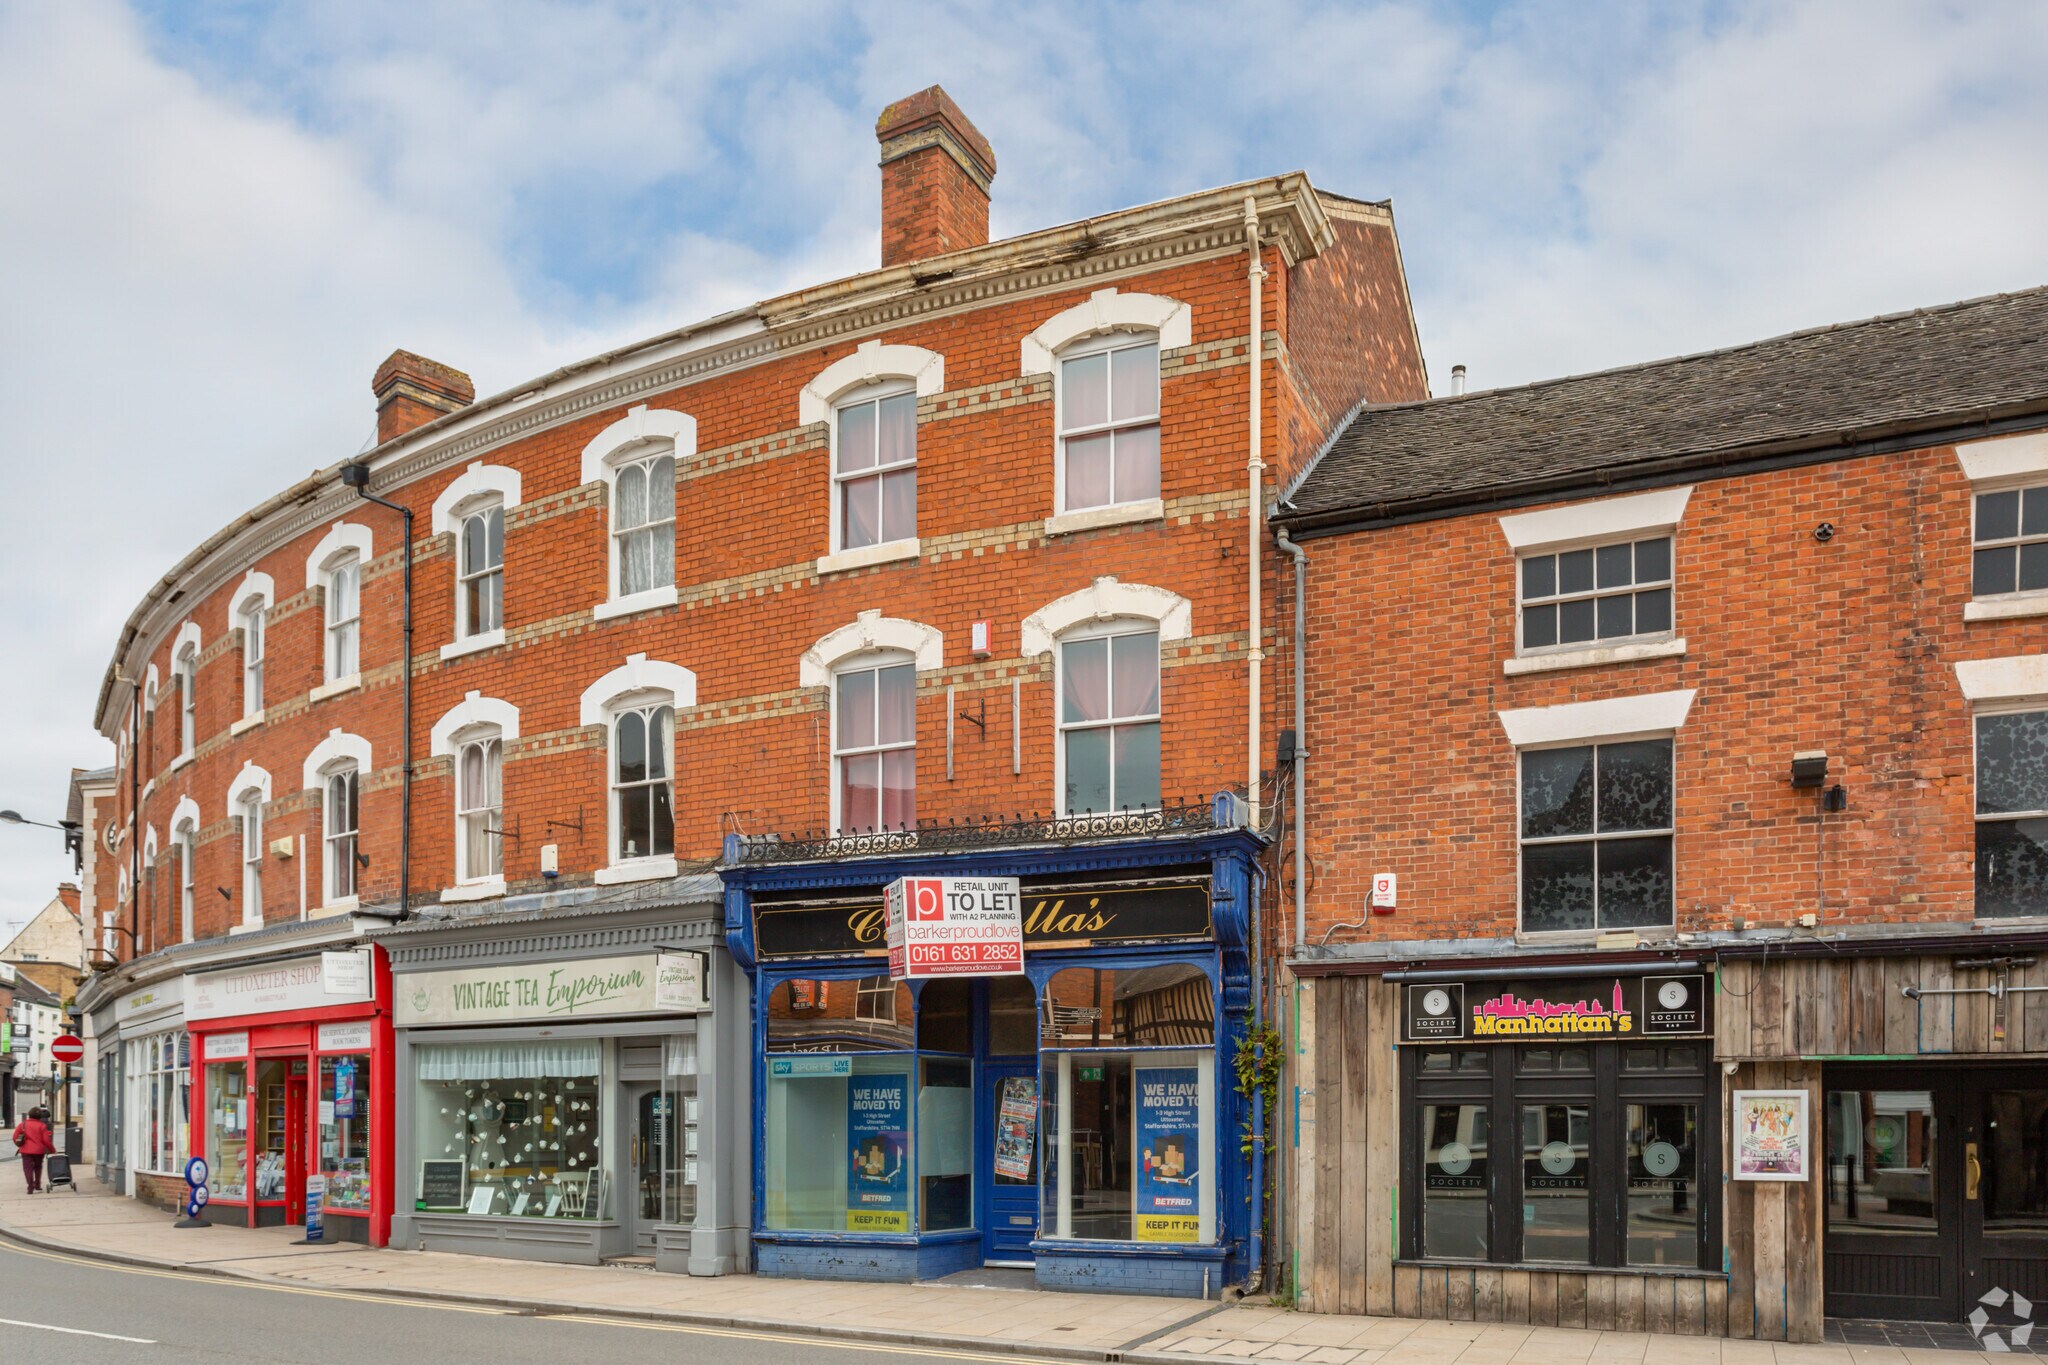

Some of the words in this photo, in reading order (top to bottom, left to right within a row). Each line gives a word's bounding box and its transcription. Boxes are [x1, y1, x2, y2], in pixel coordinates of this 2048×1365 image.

[954, 883, 985, 891] RETAIL
[988, 883, 1009, 891] UNIT
[947, 893, 975, 911] TO
[981, 893, 1016, 911] LET
[908, 923, 1020, 941] barkerproudlove
[913, 946, 945, 962] 0161
[952, 945, 977, 961] 631
[983, 945, 1018, 960] 2852
[225, 970, 289, 994] UTTOXETER
[291, 965, 321, 986] SHOP
[660, 970, 696, 986] Emporium
[453, 981, 511, 1010] VINTAGE
[515, 979, 538, 1007] TEA
[547, 969, 645, 1014] Emporium
[1670, 991, 1676, 1000] S
[1433, 998, 1440, 1007] S
[1474, 1013, 1632, 1035] Manhattan's
[776, 1063, 790, 1074] sky
[793, 1063, 832, 1072] SPORTS
[854, 1089, 871, 1100] WE
[873, 1089, 901, 1100] HAVE
[1144, 1084, 1165, 1096] WE
[854, 1101, 886, 1110] MOVED
[888, 1101, 901, 1110] TO
[1144, 1097, 1184, 1107] MOVED
[1658, 1153, 1665, 1165] S
[1431, 1178, 1482, 1186] SOCIETY
[1633, 1181, 1690, 1190] SOCIETY
[1155, 1198, 1192, 1206] BETFRED
[855, 1216, 873, 1224] KEEP
[875, 1216, 882, 1224] IT
[884, 1217, 900, 1225] FUN
[1146, 1221, 1169, 1230] KEEP
[1172, 1222, 1180, 1230] IT
